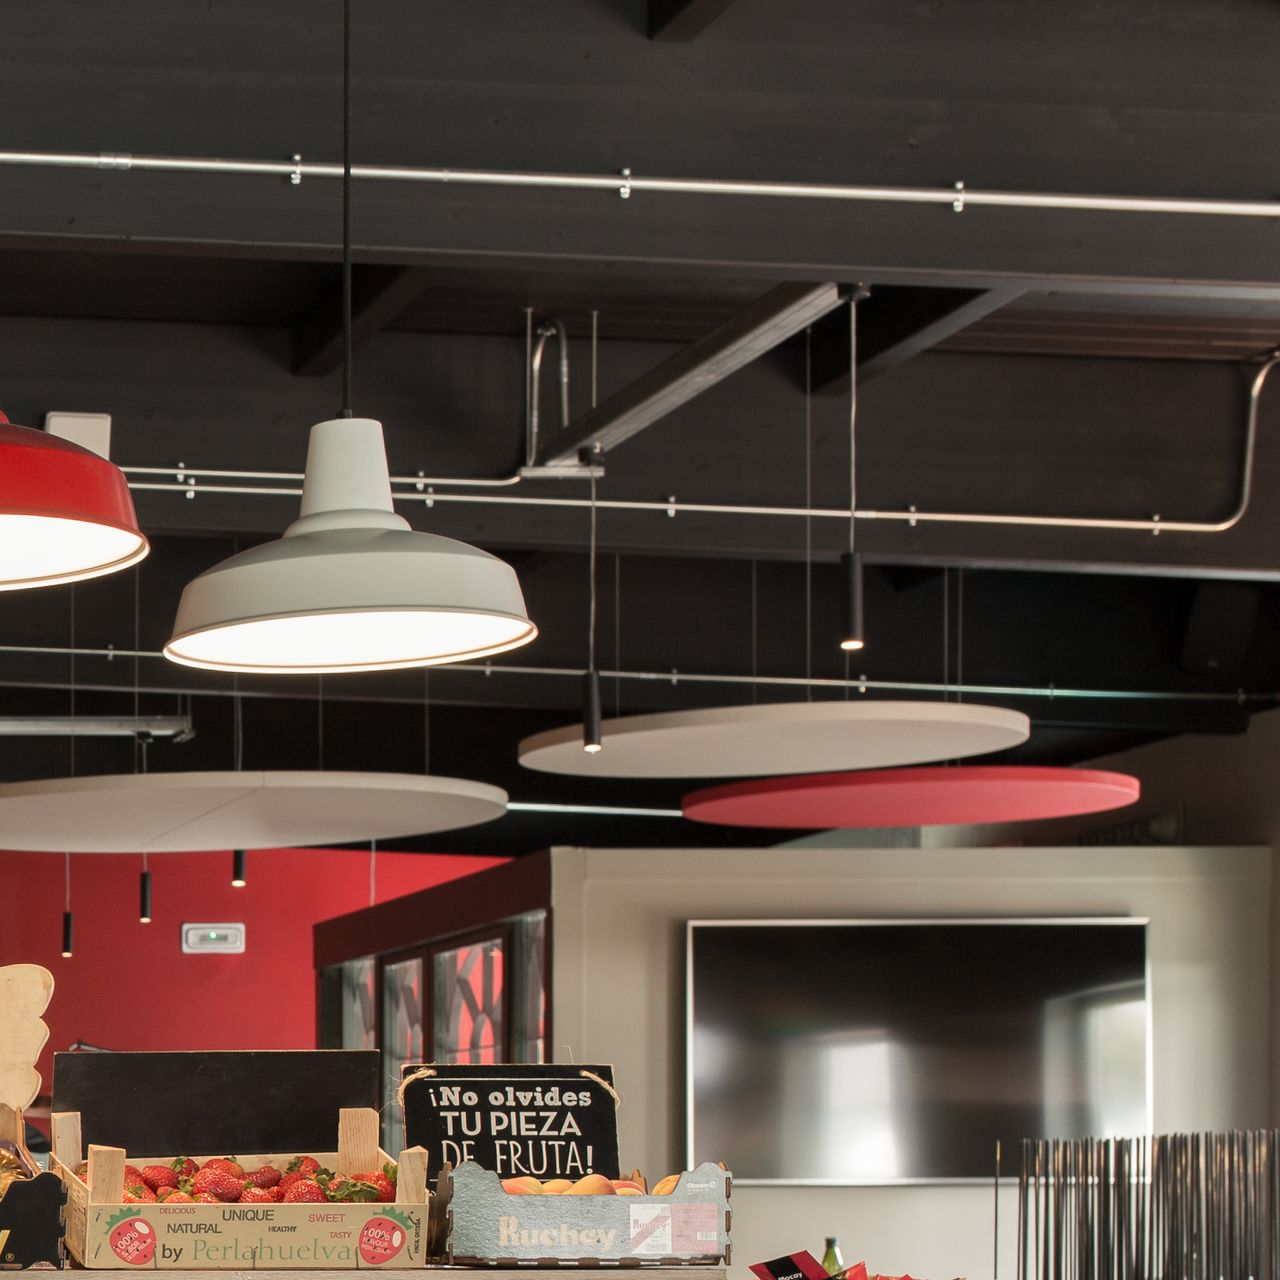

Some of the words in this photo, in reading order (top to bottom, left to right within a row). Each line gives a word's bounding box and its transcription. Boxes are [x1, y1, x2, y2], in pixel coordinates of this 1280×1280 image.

[429, 1087, 478, 1107] ¡No
[488, 1086, 592, 1107] olvides
[440, 1112, 482, 1136] TU
[490, 1112, 582, 1136] PIEZA
[441, 1140, 475, 1168] DE
[494, 1140, 594, 1175] FRUTA!
[159, 1207, 196, 1215] DELICIOUS
[222, 1209, 275, 1223] UNIQUE
[308, 1213, 346, 1223] SWEET
[167, 1223, 222, 1235] NATURAL
[268, 1225, 297, 1233] HEALTHY
[329, 1231, 352, 1239] TASTY
[364, 1226, 390, 1241] 100%
[498, 1215, 617, 1251] Ruchey
[162, 1243, 183, 1263] by
[192, 1238, 351, 1262] Perlahuelva
